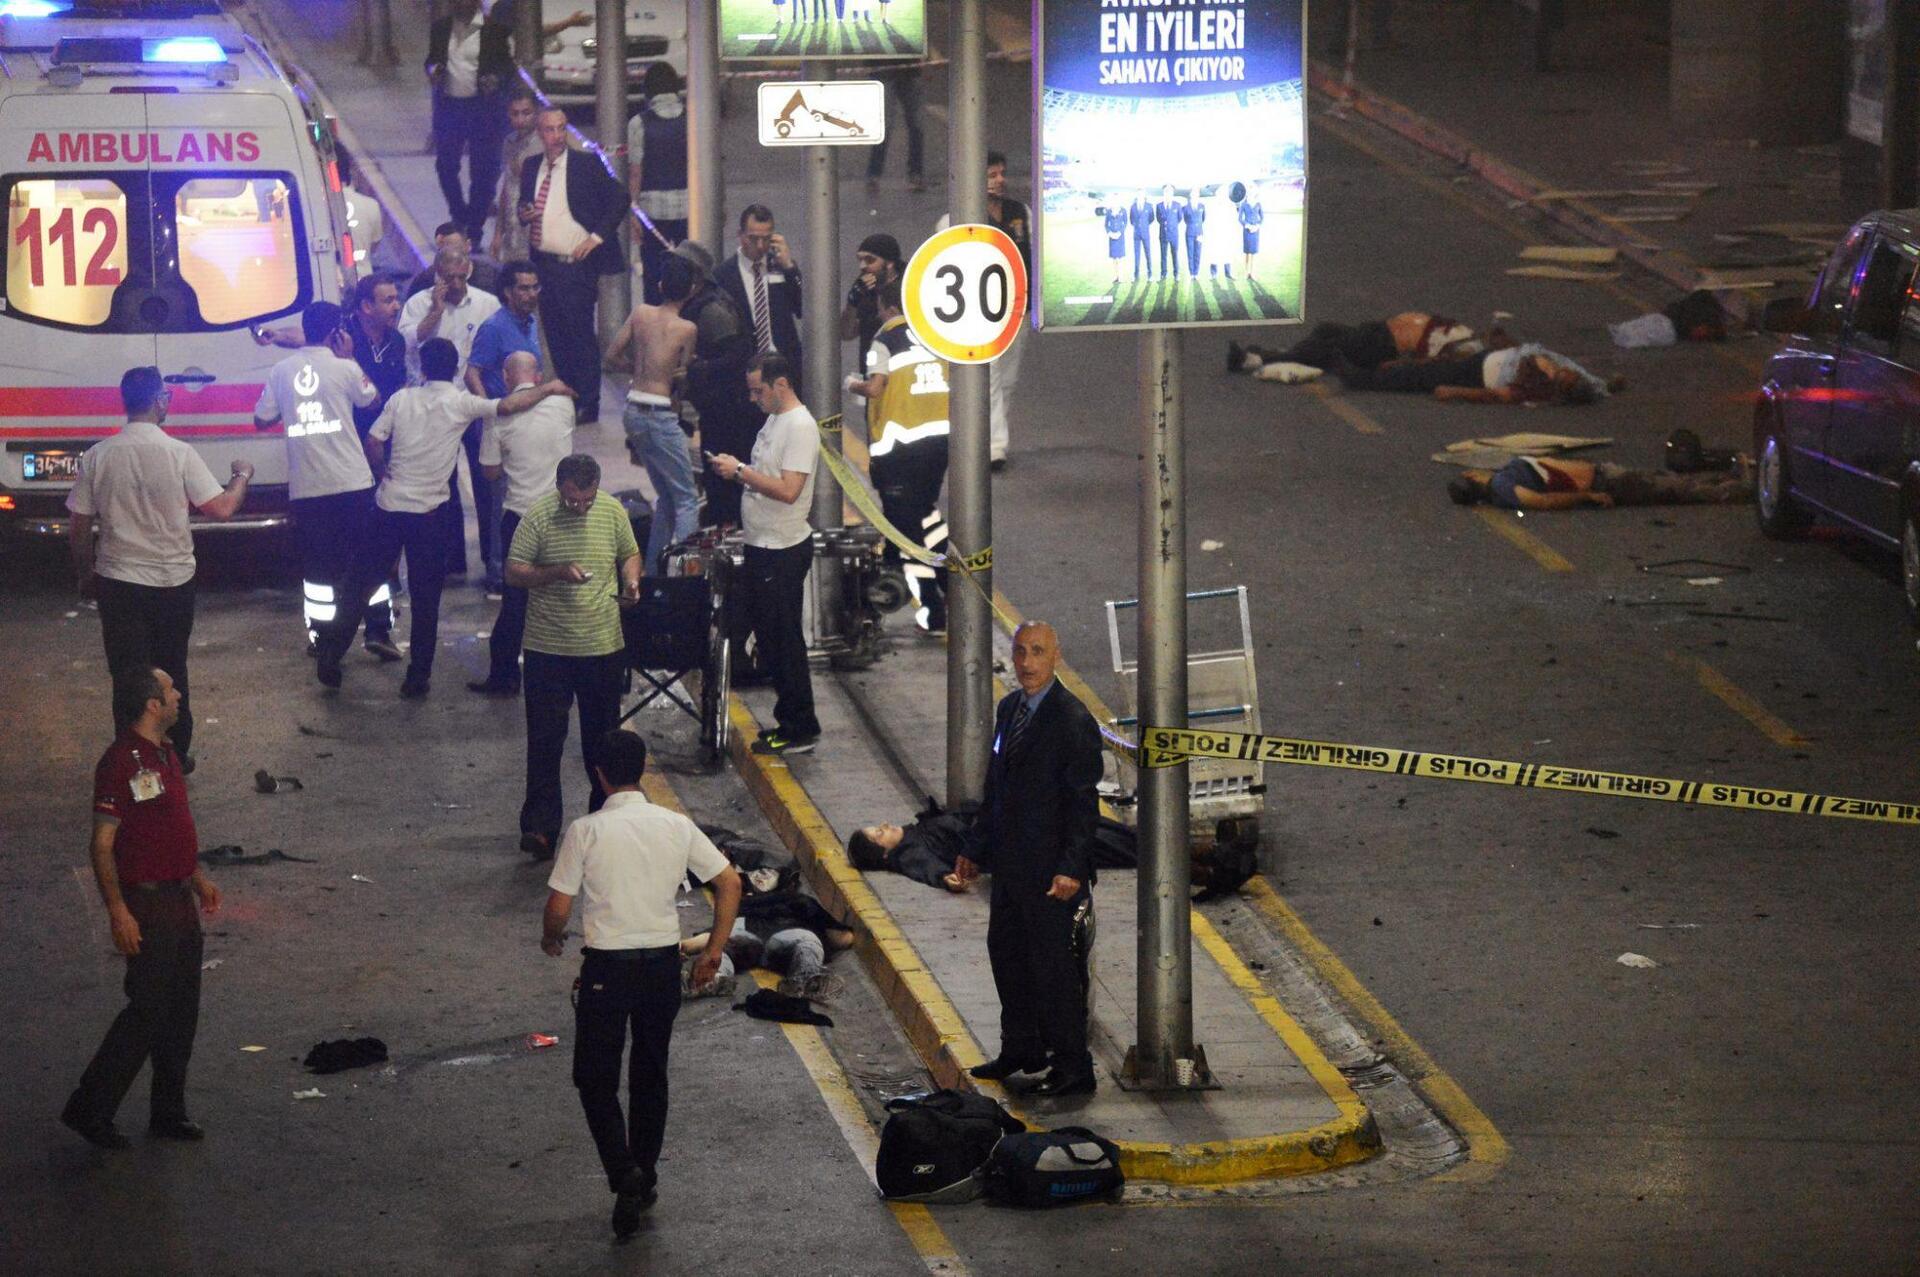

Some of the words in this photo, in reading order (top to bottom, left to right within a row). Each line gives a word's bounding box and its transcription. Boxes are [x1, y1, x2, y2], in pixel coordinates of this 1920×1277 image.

[1100, 12, 1137, 53] EN
[1146, 9, 1245, 52] İYİLERİ
[1099, 58, 1170, 85] SAHAYA
[1174, 56, 1245, 86] ÇIKIYOR
[26, 131, 261, 163] AMBULANS
[15, 207, 120, 287] 112
[933, 263, 1008, 323] 30
[1154, 732, 1231, 753] POLİS
[1266, 740, 1391, 768] GİRİLMEZ
[1429, 757, 1508, 780] POLİS
[1543, 769, 1672, 796] GİRİLMEZ
[1712, 786, 1793, 808] POLİS
